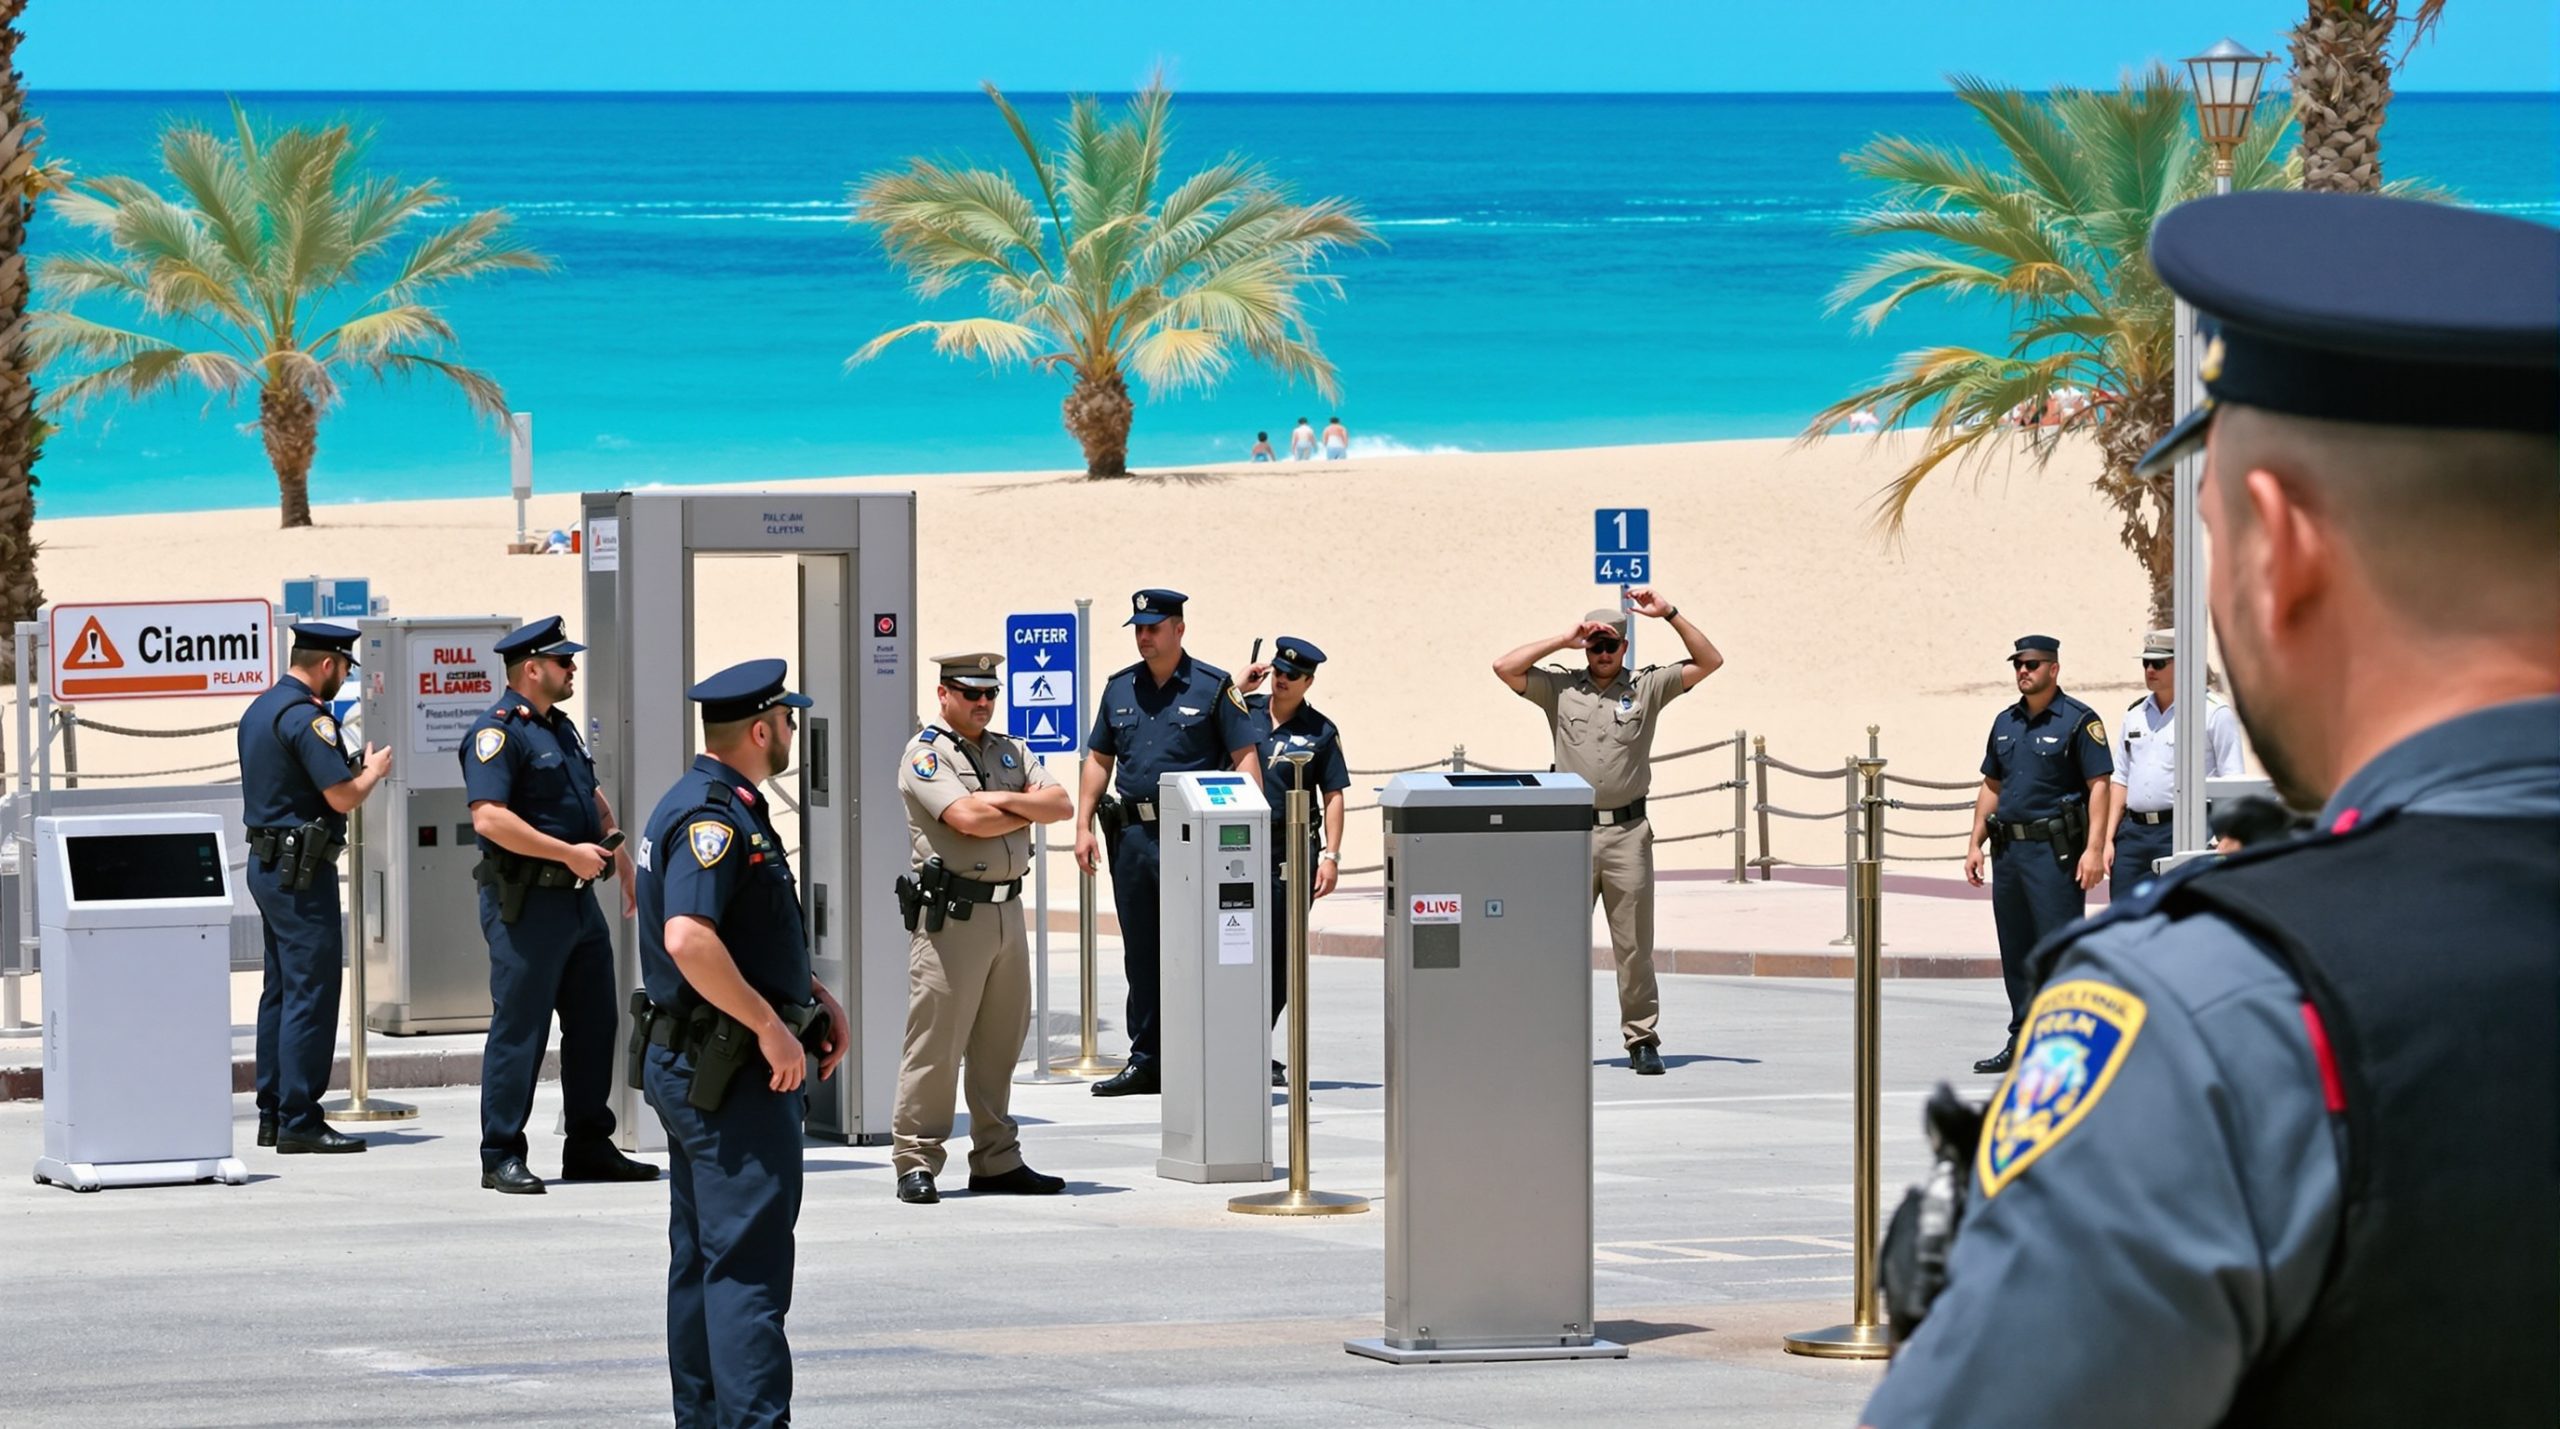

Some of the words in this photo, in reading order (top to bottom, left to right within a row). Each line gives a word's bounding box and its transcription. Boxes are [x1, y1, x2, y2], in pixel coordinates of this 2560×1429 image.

[1613, 511, 1627, 549] 1
[138, 623, 259, 664] Cianmi
[213, 671, 263, 685] PELARK
